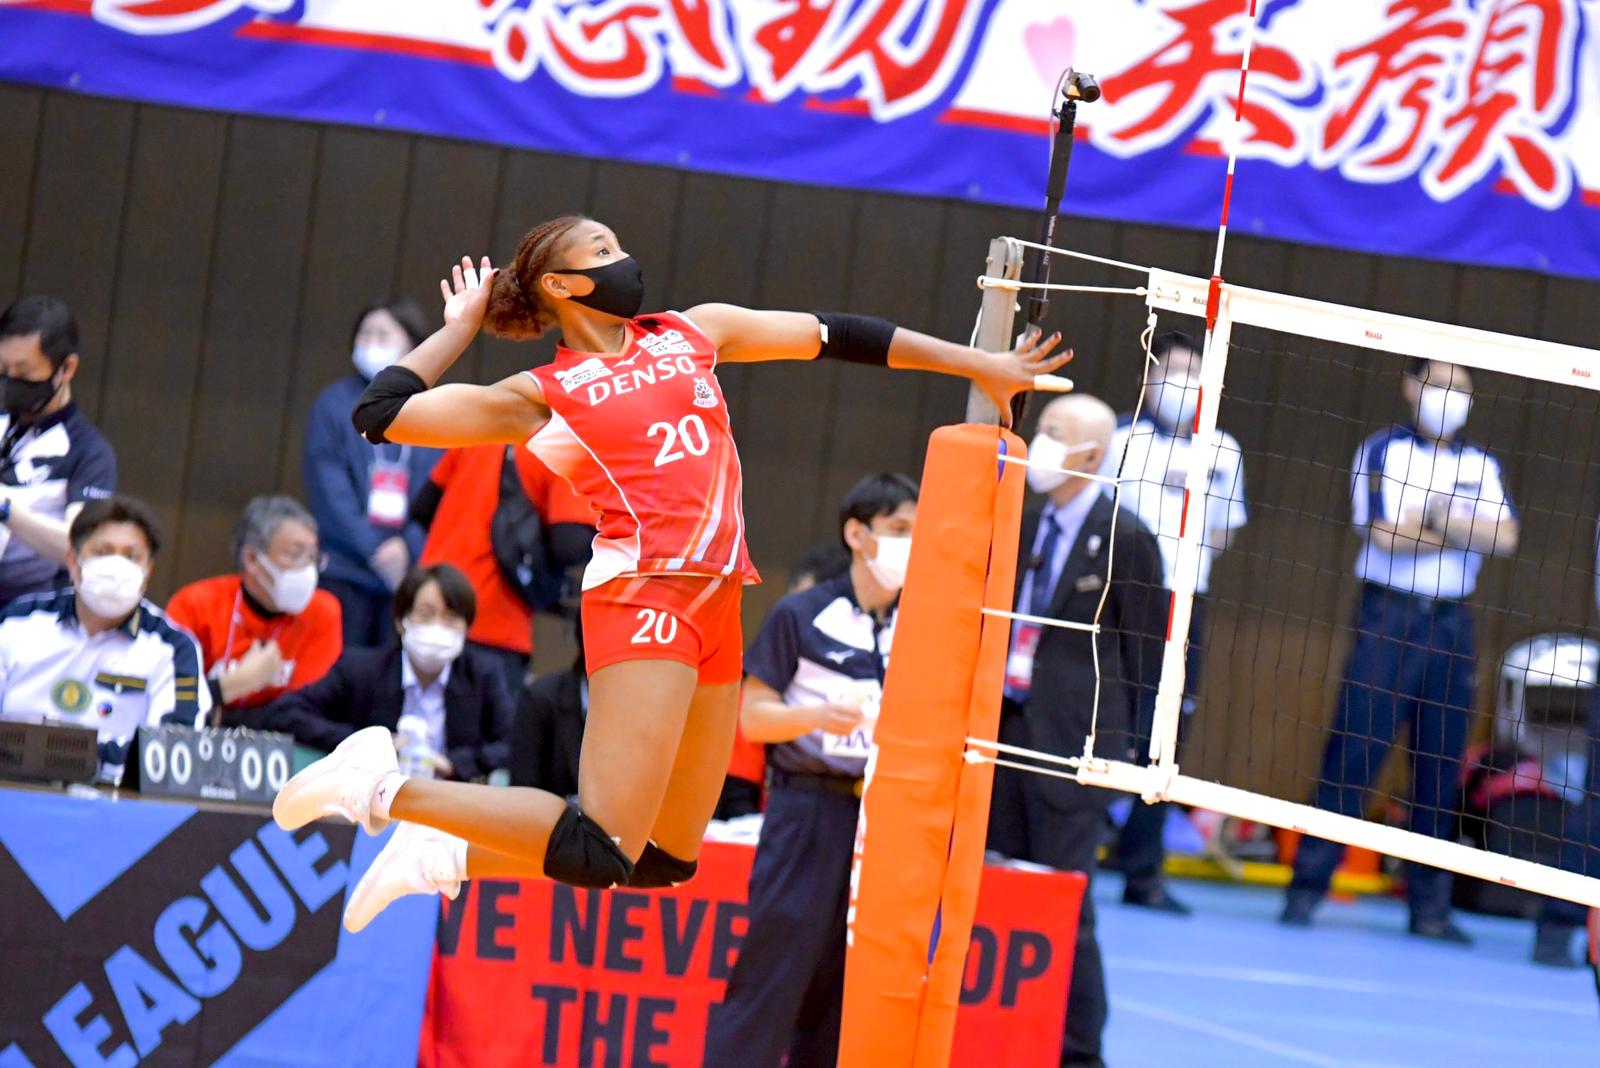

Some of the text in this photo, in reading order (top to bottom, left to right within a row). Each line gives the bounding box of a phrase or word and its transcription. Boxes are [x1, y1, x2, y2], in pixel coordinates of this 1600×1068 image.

[586, 355, 696, 406] DENSO
[647, 414, 710, 467] 20
[631, 608, 677, 644] 20
[144, 740, 192, 785] 00
[0, 820, 349, 1068] EAGUE
[531, 984, 676, 1068] THE
